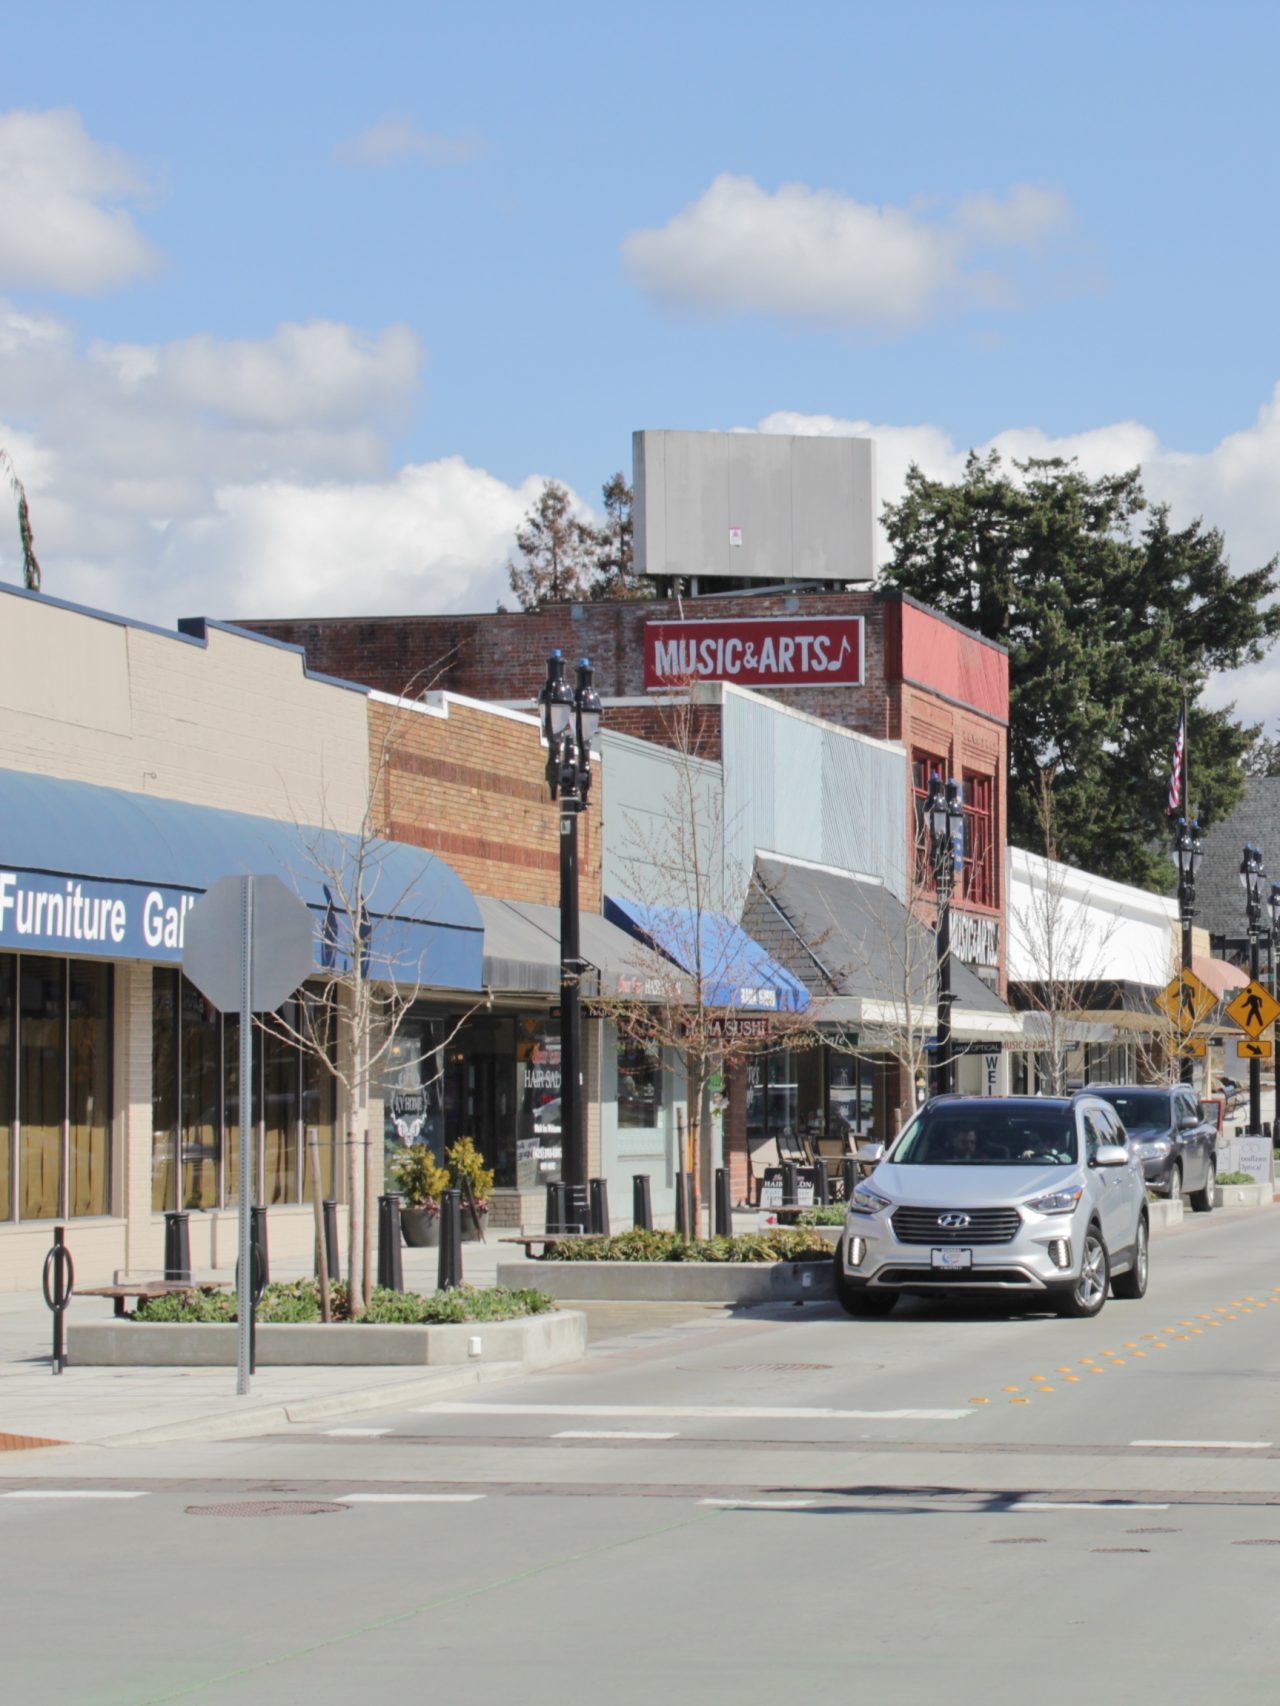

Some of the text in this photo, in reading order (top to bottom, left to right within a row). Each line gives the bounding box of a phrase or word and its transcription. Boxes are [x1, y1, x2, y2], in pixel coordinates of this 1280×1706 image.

[0, 872, 127, 943] Furniture
[726, 1020, 766, 1037] SUSHI
[970, 1043, 999, 1053] OPTICAL
